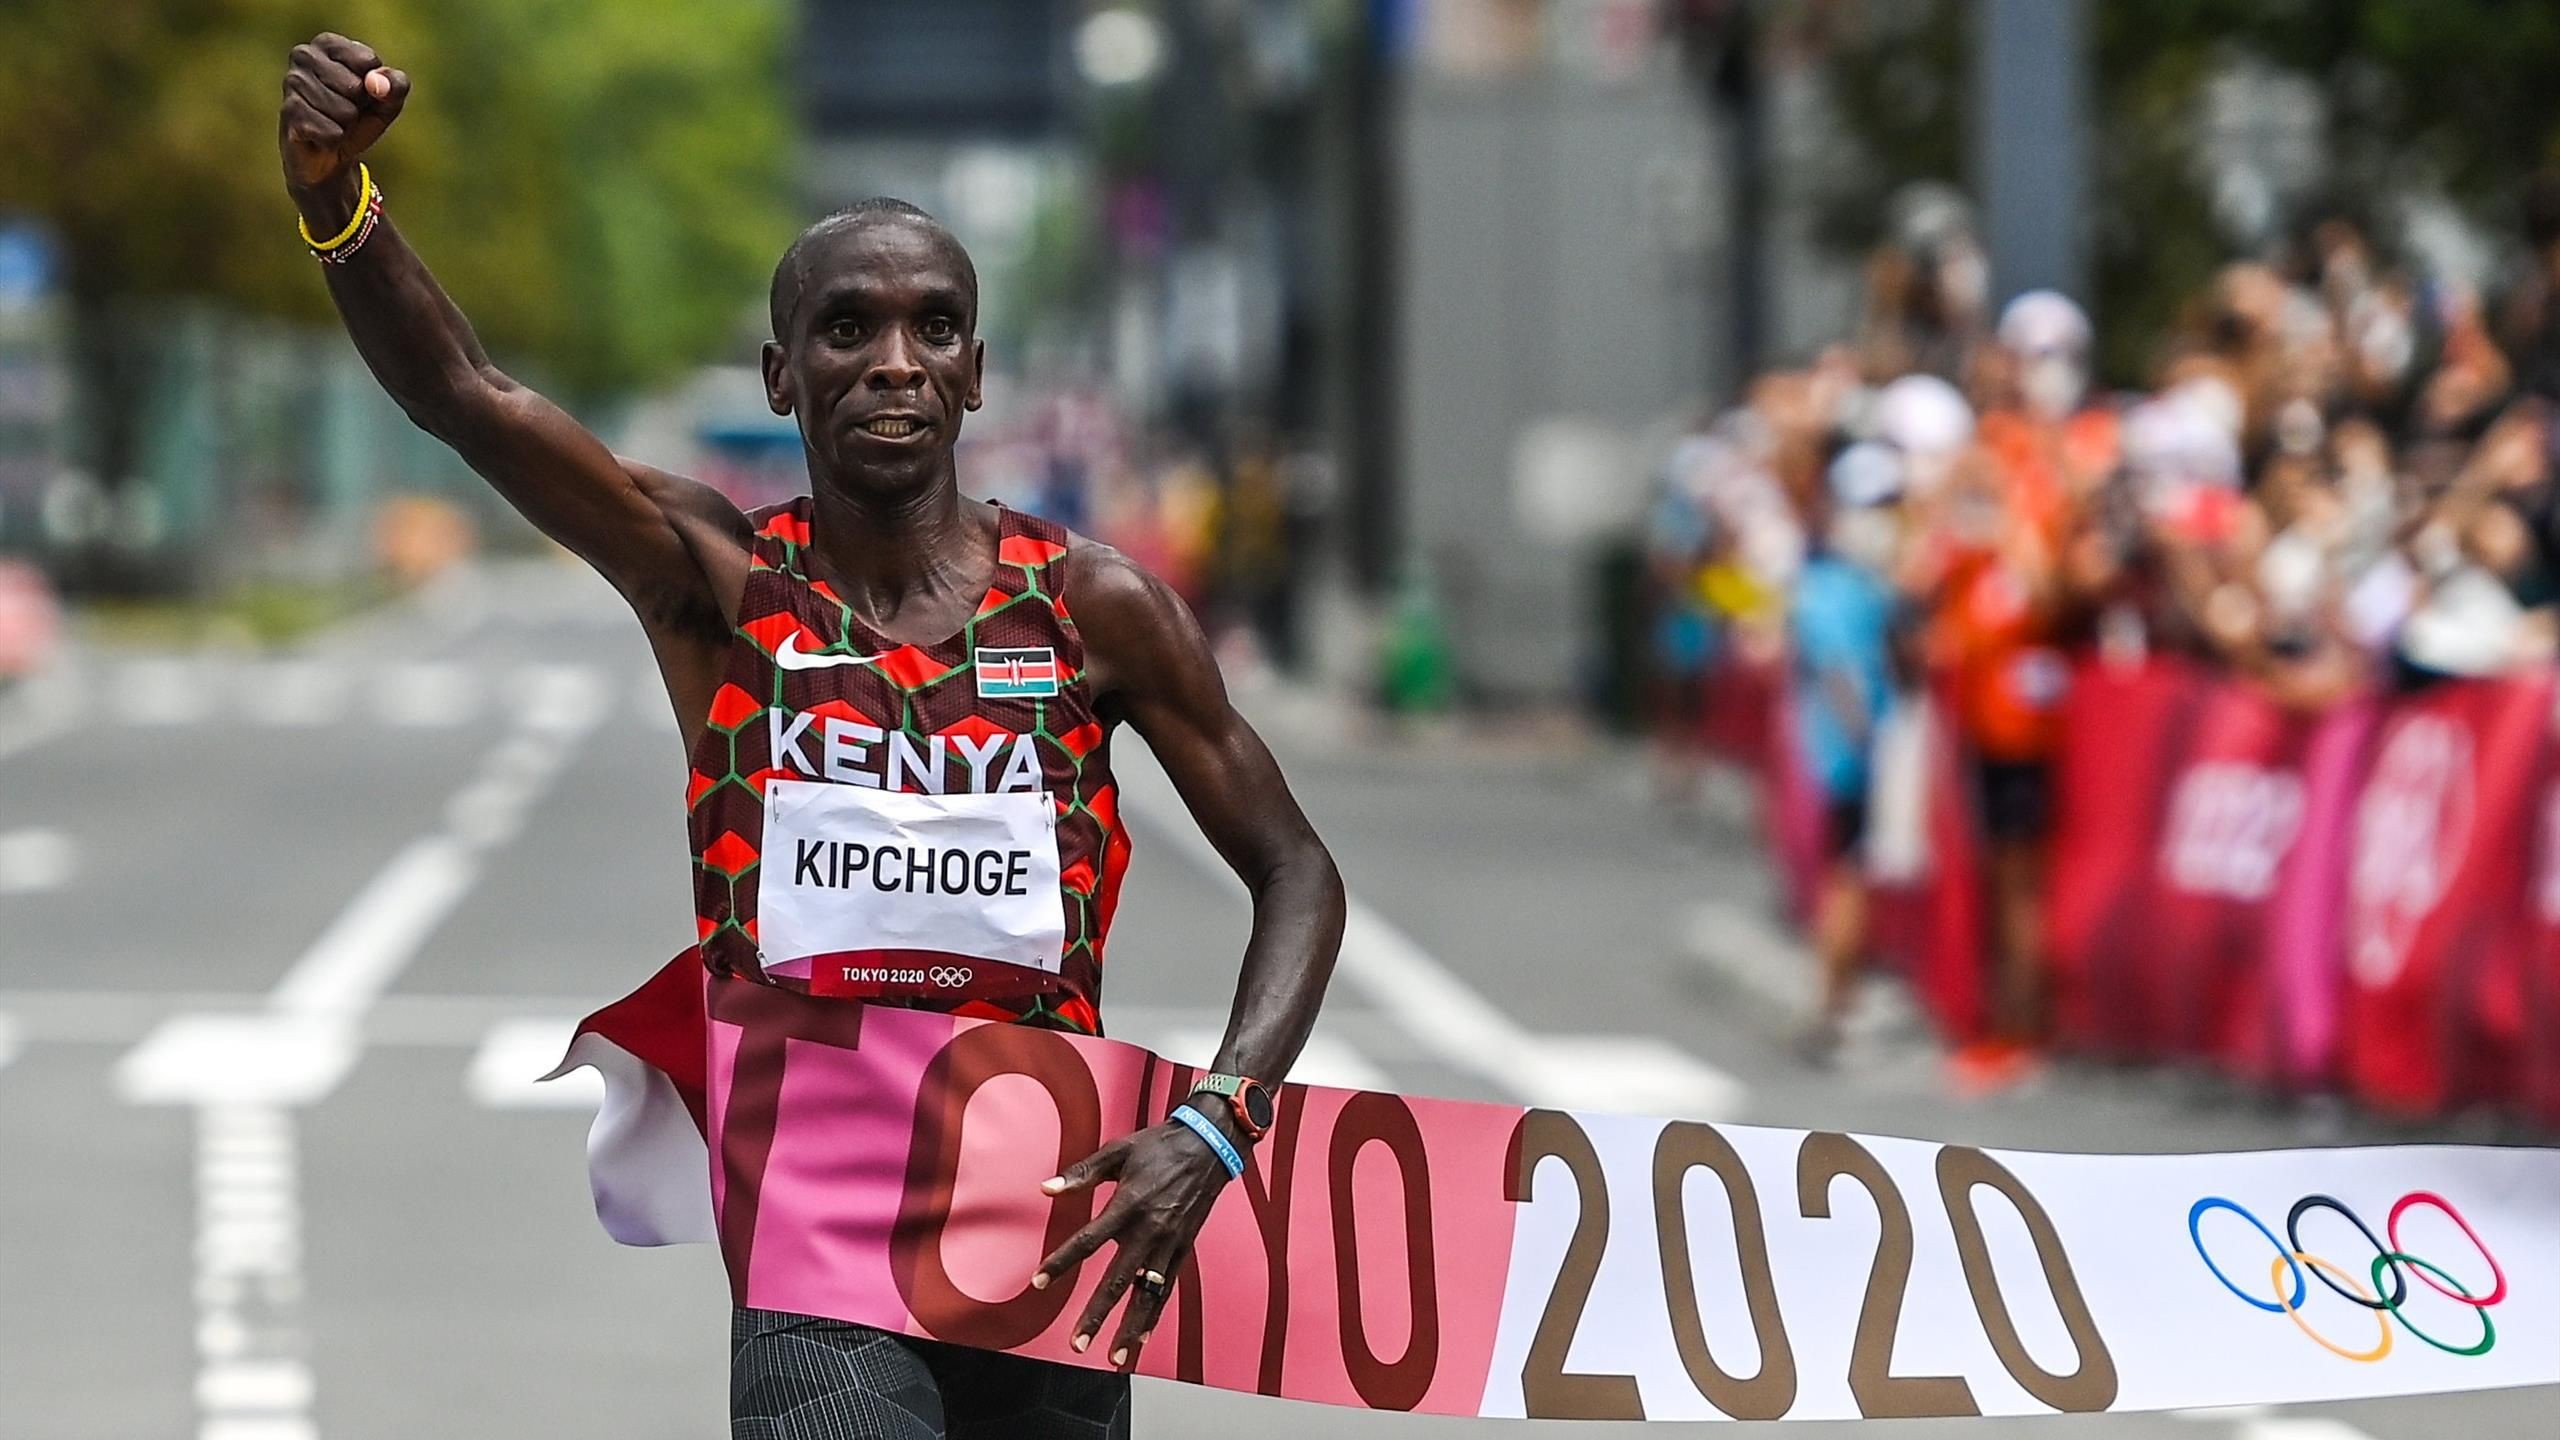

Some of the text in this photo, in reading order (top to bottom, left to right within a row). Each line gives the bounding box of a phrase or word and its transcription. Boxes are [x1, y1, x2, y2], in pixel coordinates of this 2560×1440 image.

[769, 706, 1044, 794] KENYA
[794, 838, 1031, 896] KIPCHOGE
[842, 967, 925, 983] TOKYO 2020
[1503, 1107, 2118, 1421] 2020
